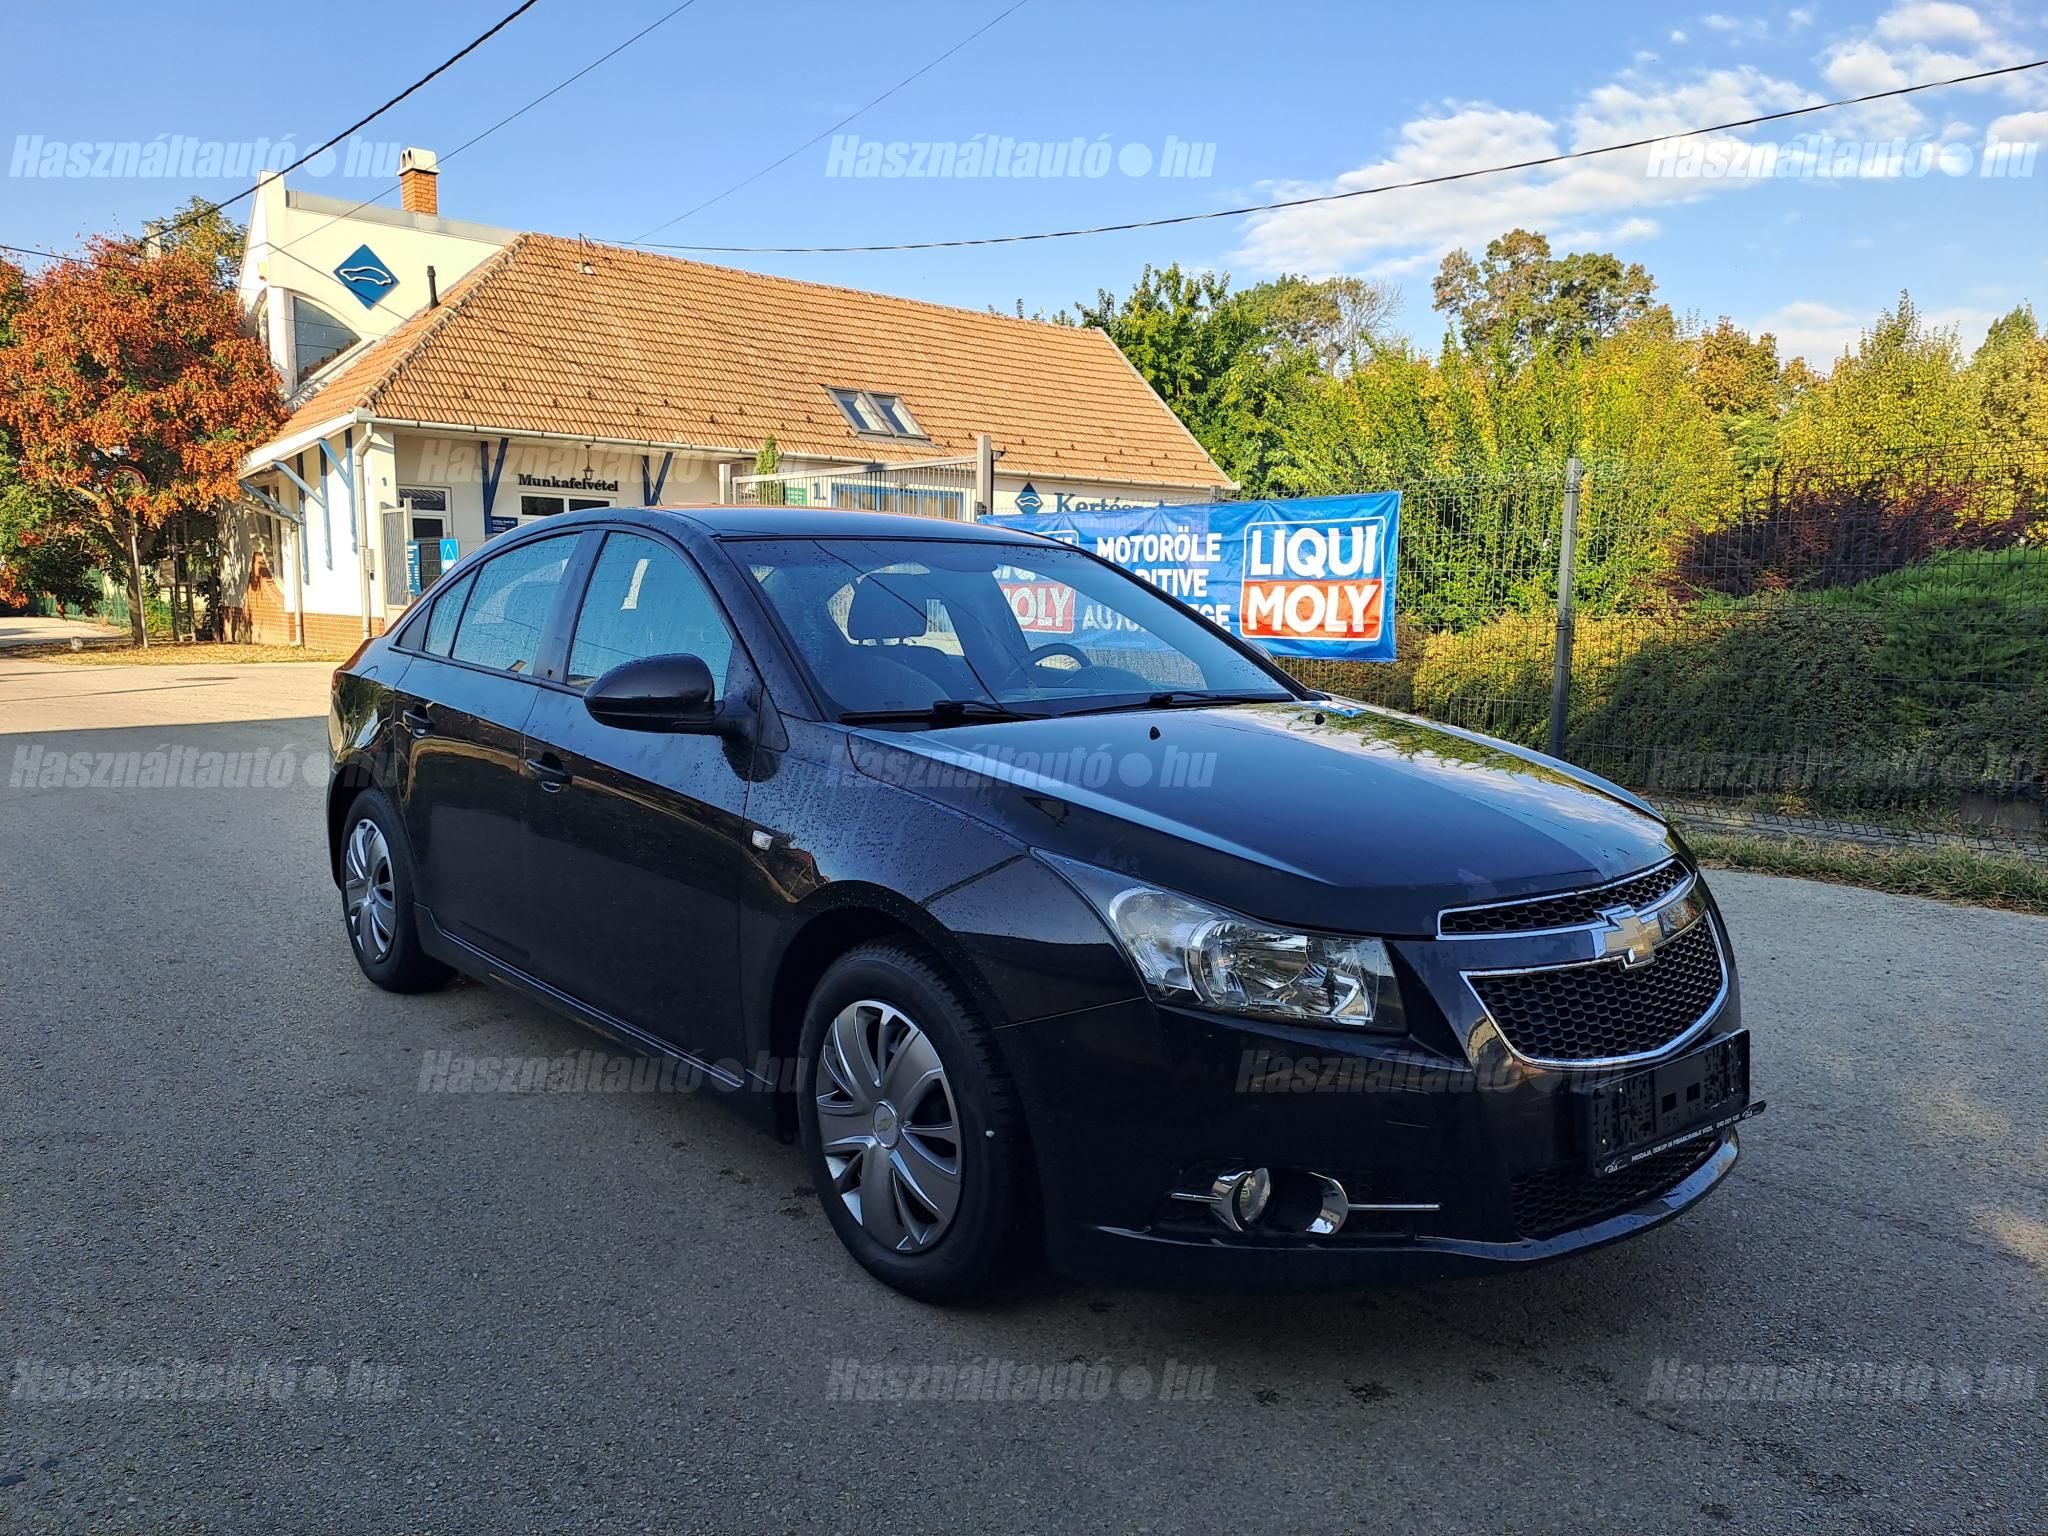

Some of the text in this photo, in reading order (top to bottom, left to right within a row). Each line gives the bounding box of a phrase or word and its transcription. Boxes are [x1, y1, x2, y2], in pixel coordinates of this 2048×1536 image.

[518, 473, 619, 492] Munkafelvétel
[1097, 525, 1222, 563] MOTORÖLE
[1250, 525, 1378, 579] LIQUI
[1247, 584, 1379, 633] MOLY
